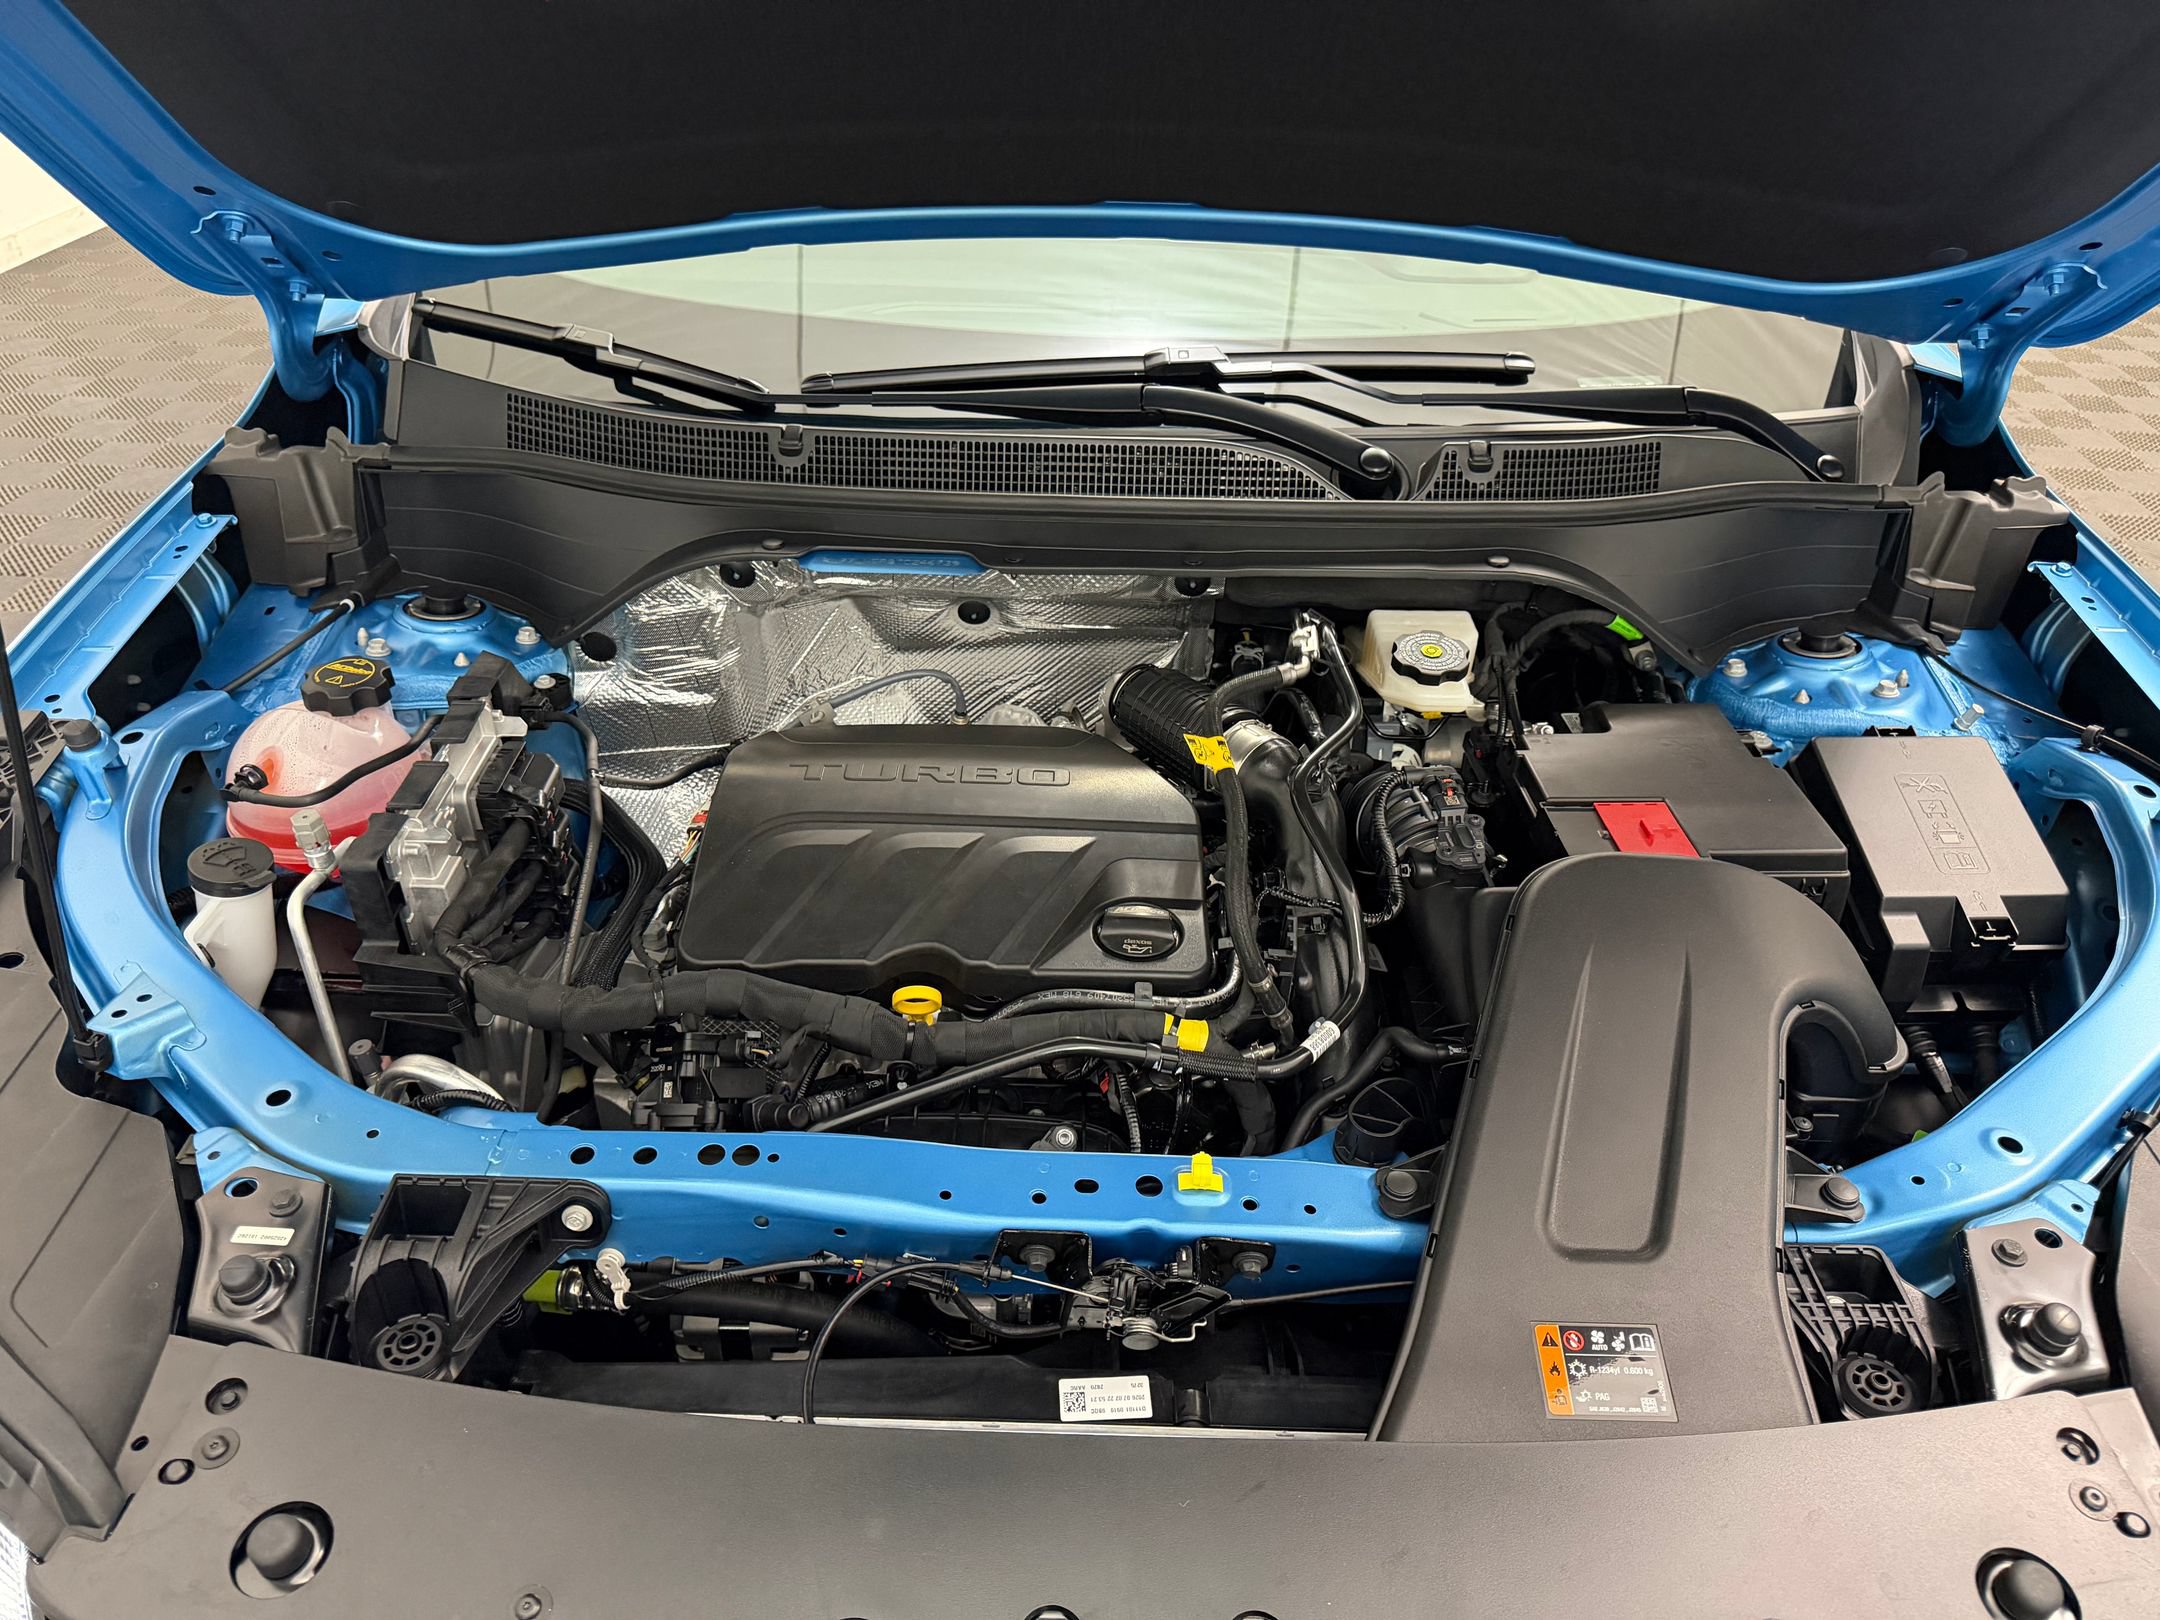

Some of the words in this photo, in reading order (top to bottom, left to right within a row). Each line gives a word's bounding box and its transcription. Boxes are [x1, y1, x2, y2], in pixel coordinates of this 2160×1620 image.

[788, 762, 1072, 787] TURBO
[1124, 937, 1153, 945] dexos
[1037, 991, 1057, 1001] MEX
[1643, 1367, 1654, 1377] kg
[1595, 1392, 1611, 1401] PAG
